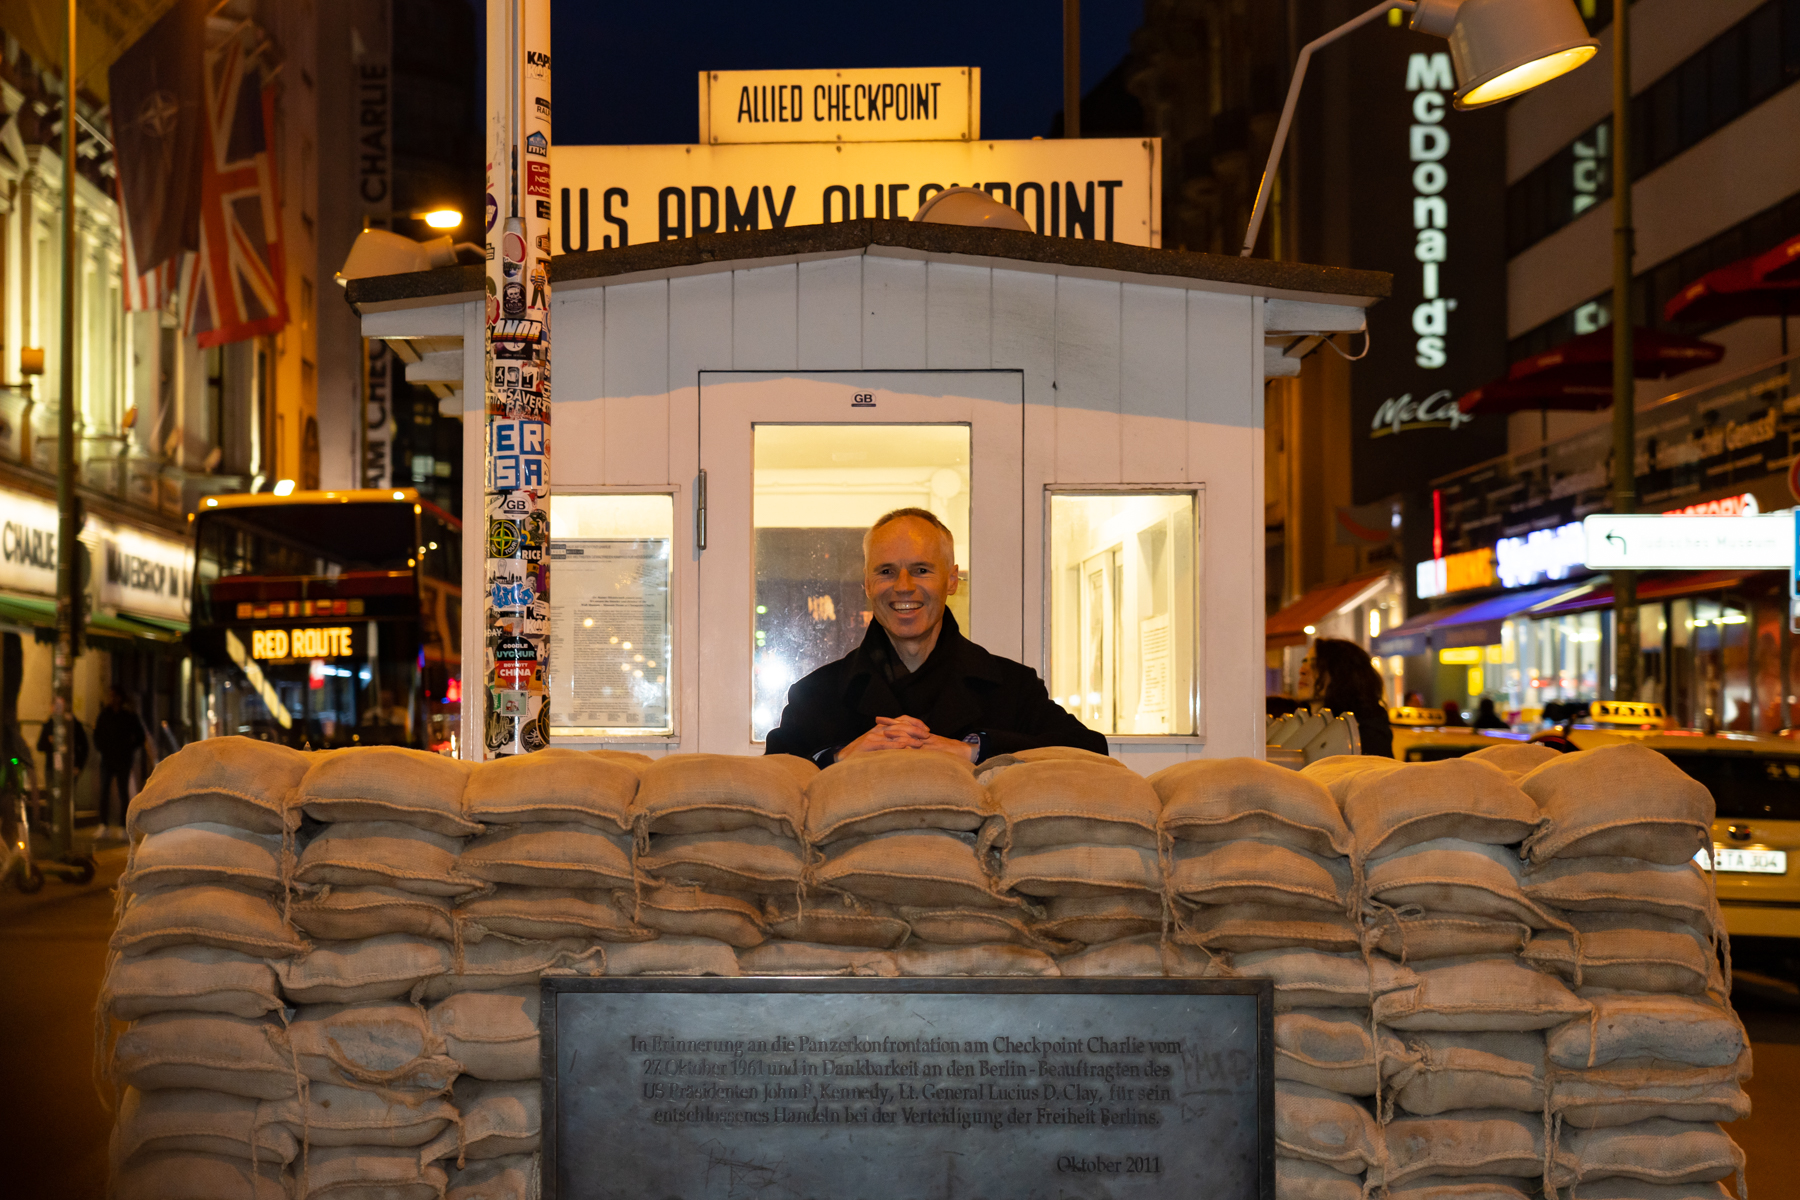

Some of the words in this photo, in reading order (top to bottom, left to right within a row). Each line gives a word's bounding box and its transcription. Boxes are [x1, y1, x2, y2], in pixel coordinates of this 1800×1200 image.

[737, 85, 803, 123] ALLIED
[813, 82, 942, 122] CHECKPOINT
[560, 186, 629, 253] US
[658, 184, 797, 242] ARMY
[822, 180, 1123, 244] HEOINT
[854, 393, 873, 404] GB
[506, 500, 526, 510] GB
[252, 629, 289, 660] RED
[291, 627, 353, 658] ROUTE
[496, 650, 535, 658] UYGHUR
[500, 668, 532, 677] CHINA
[630, 1035, 647, 1053] In
[652, 1035, 745, 1058] Erinnerung
[747, 1039, 767, 1053] an
[771, 1035, 796, 1053] die
[798, 1035, 960, 1053] Panzerkonfrontation
[964, 1040, 989, 1054] am
[992, 1036, 1084, 1059] Checkpoint
[1086, 1036, 1145, 1054] Charlie
[1147, 1041, 1183, 1055] vom
[664, 1059, 728, 1077] Oktober
[730, 1059, 764, 1076] 1961
[766, 1059, 798, 1077] und
[801, 1059, 818, 1077] in
[821, 1059, 920, 1077] Dankbarkeit
[922, 1063, 943, 1077] an
[946, 1059, 975, 1078] den
[1144, 1060, 1171, 1078] des
[642, 1082, 665, 1100] US
[668, 1082, 759, 1100] Präsidenten
[761, 1083, 798, 1103] John
[819, 1082, 895, 1105] Kennedy,
[898, 1083, 919, 1100] Lt.
[921, 1083, 985, 1100] General
[988, 1083, 1039, 1101] Lucius
[1043, 1083, 1060, 1101] D.
[1063, 1083, 1103, 1106] Clay,
[1108, 1083, 1133, 1101] für
[1137, 1084, 1171, 1101] sein
[653, 1106, 770, 1124] entschlossenes
[773, 1106, 840, 1124] Handeln
[845, 1106, 868, 1124] bei
[871, 1106, 898, 1124] der
[901, 1106, 1004, 1130] Verteidigung
[1006, 1107, 1033, 1125] der
[1035, 1107, 1097, 1125] Freiheit
[1100, 1107, 1160, 1125] Berlins.
[1056, 1156, 1122, 1174] Oktober
[1125, 1156, 1162, 1174] 2011
